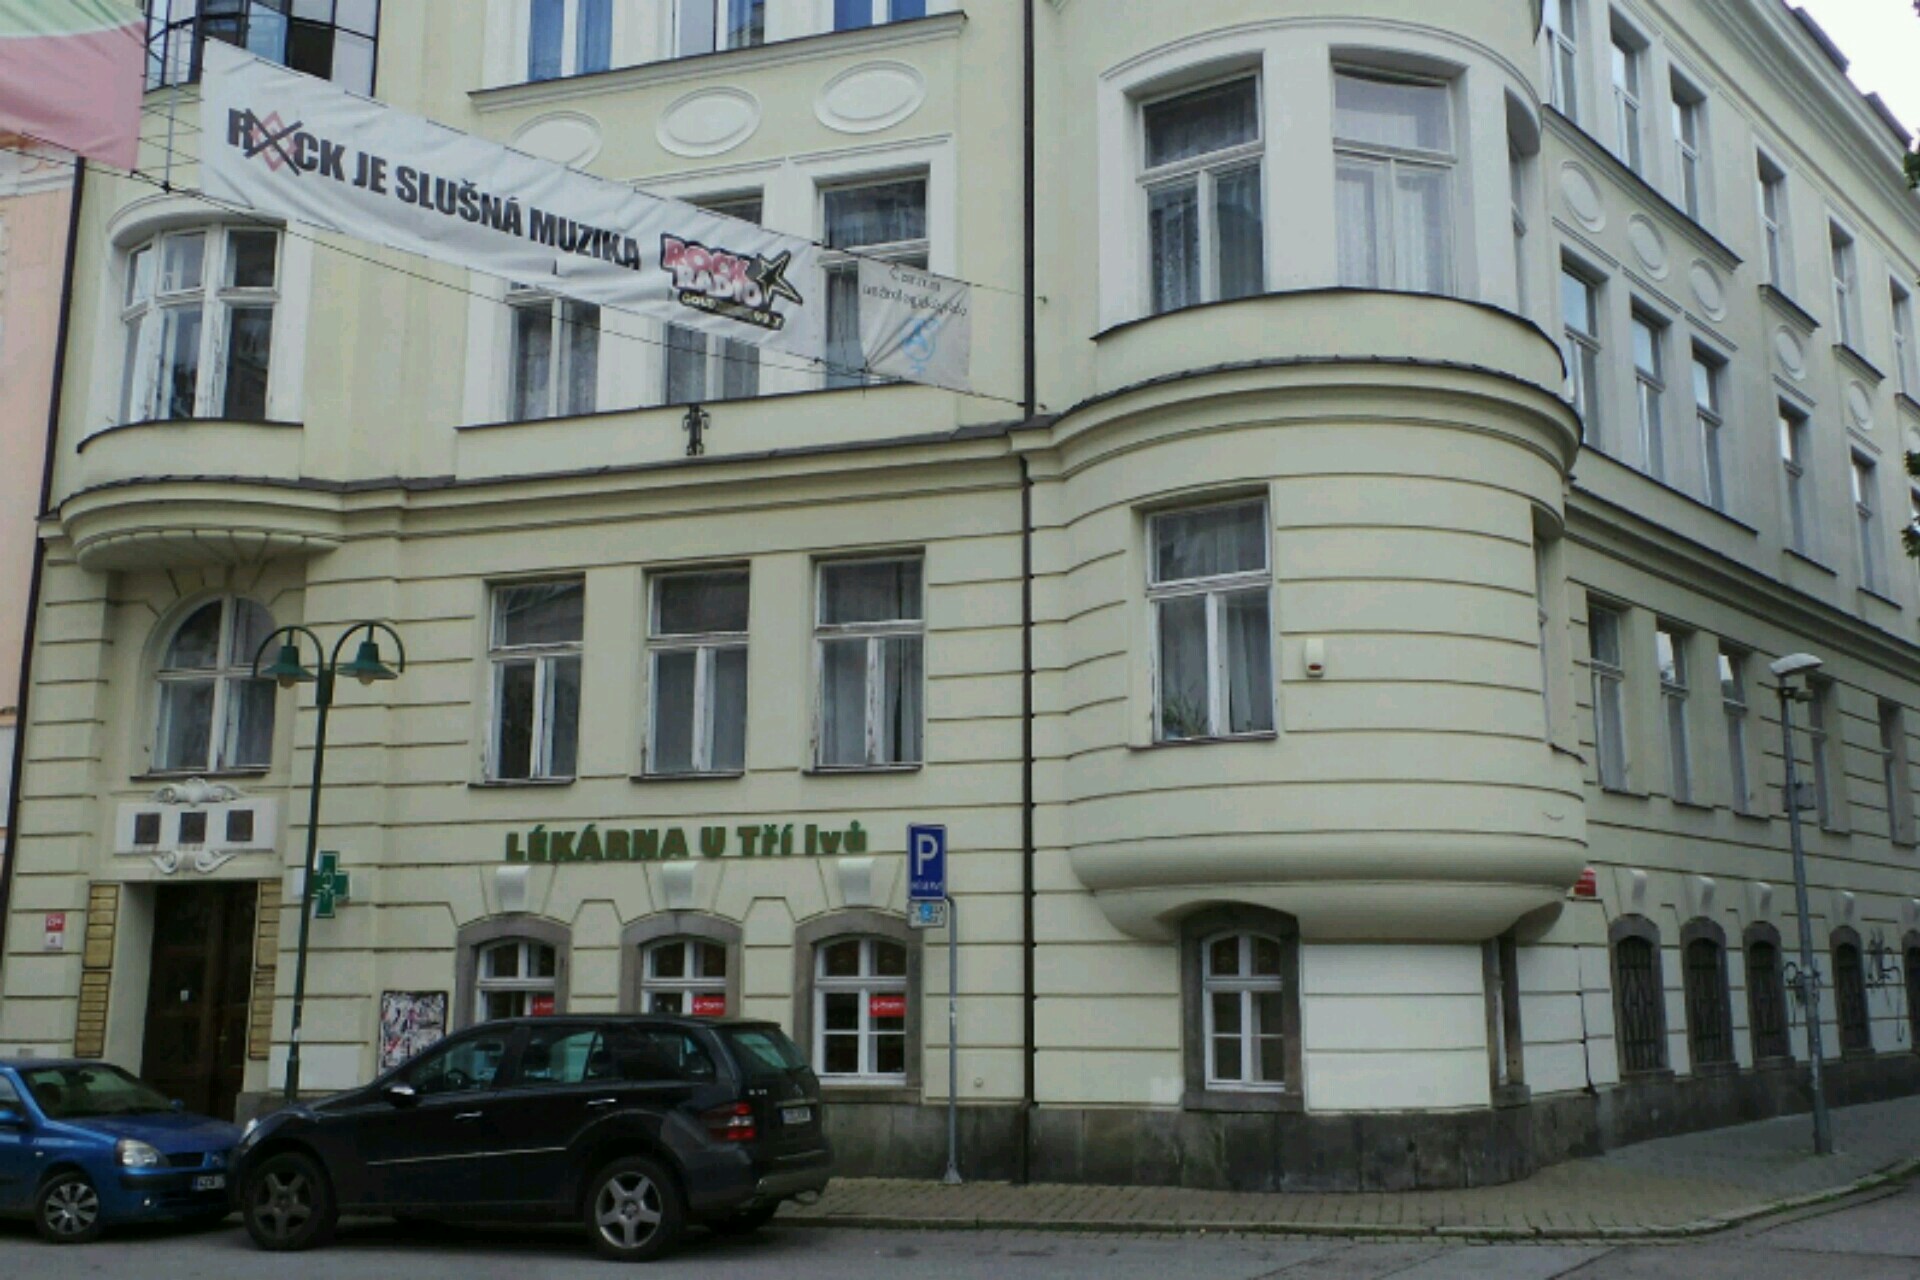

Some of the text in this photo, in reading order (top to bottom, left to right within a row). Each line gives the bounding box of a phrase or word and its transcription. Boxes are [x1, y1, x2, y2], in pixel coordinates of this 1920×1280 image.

[352, 151, 387, 195] JE
[395, 165, 523, 237] SLUŠNÁ
[529, 206, 641, 271] MUZIKA
[662, 236, 750, 284] ROCK
[676, 265, 763, 308] RADIO
[506, 819, 867, 862] LÉKÁRNA U Tří lvů
[917, 833, 938, 876] P
